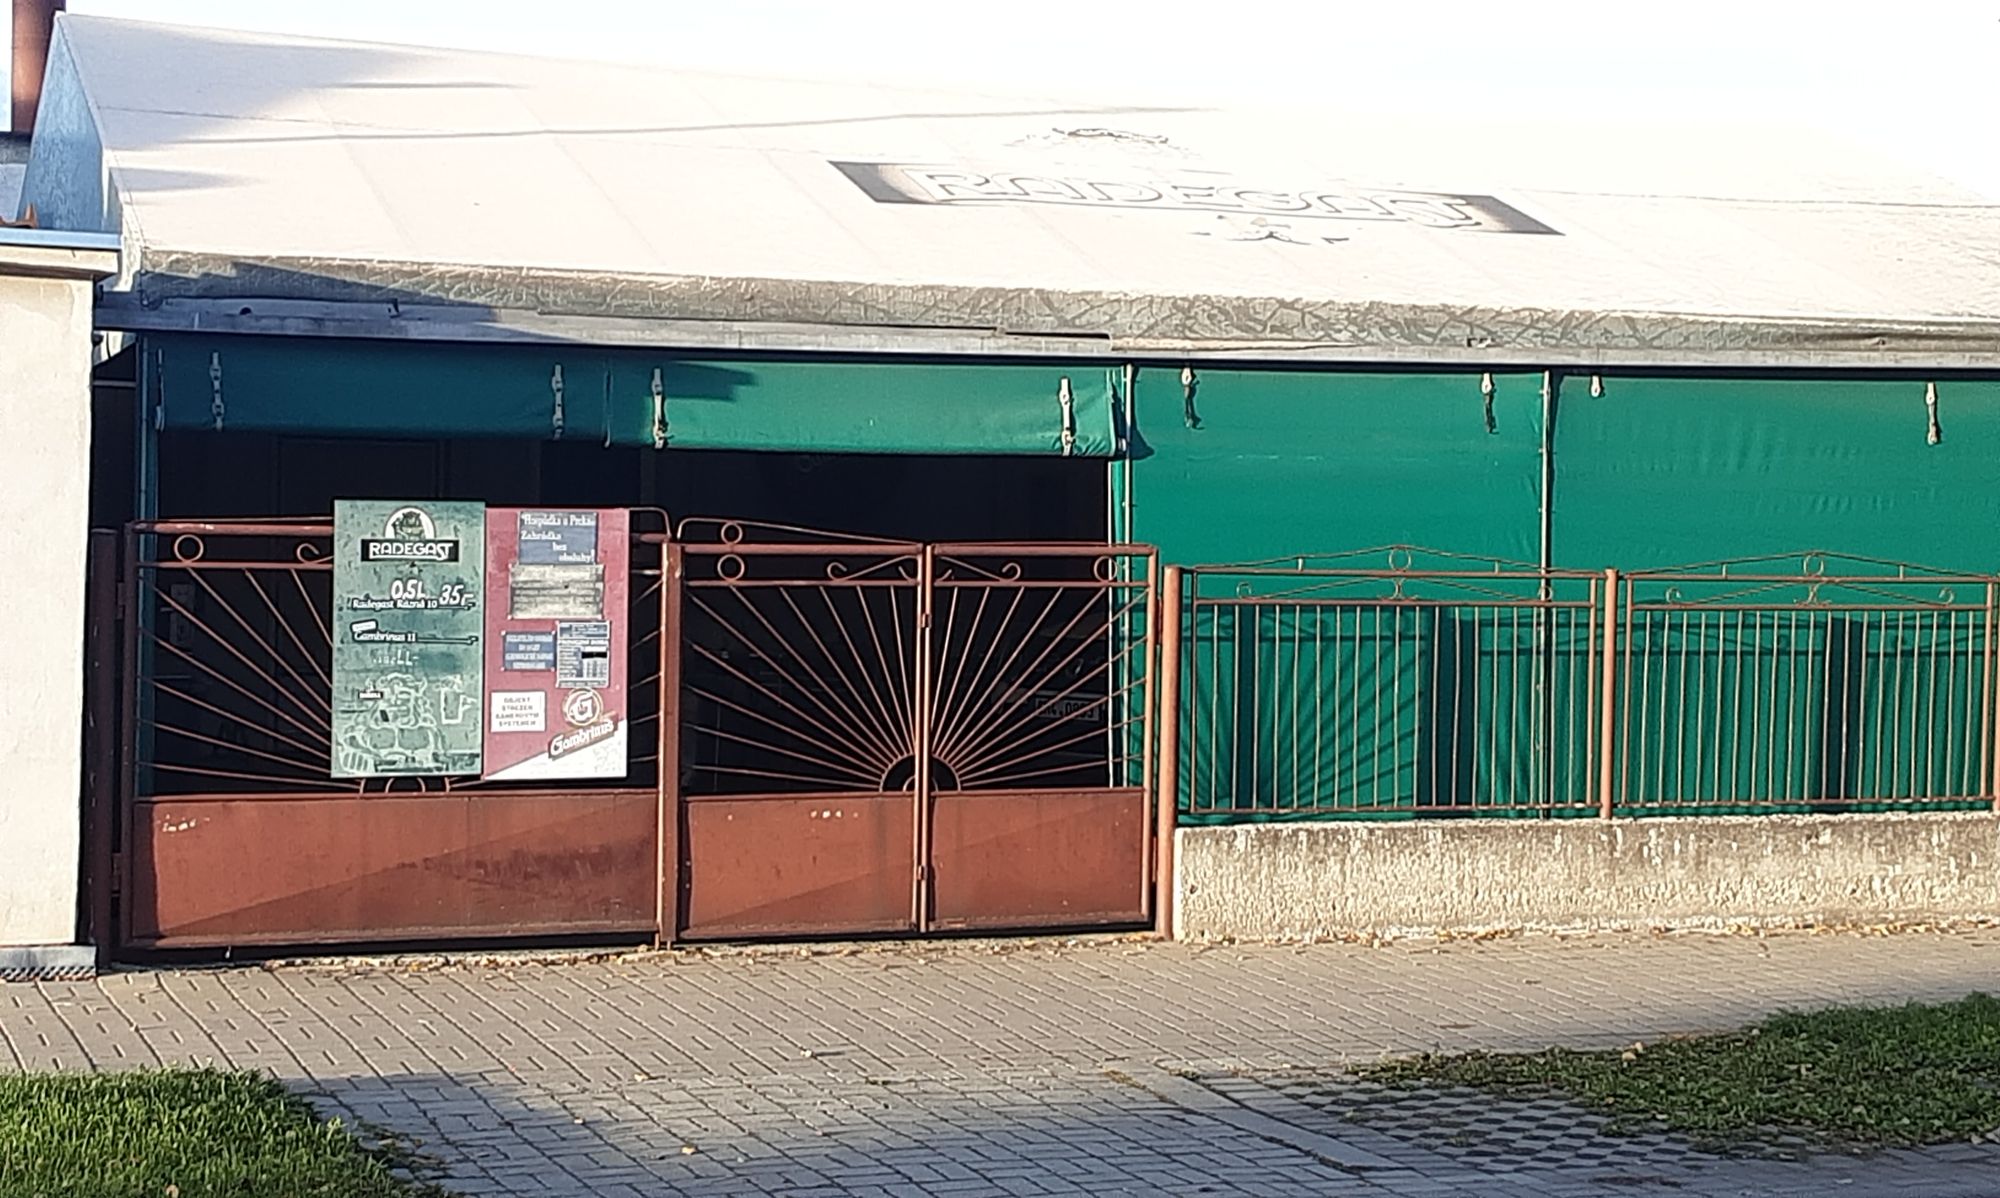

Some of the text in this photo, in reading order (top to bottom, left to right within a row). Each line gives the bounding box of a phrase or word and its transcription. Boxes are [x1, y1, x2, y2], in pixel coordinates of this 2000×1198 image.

[905, 168, 1482, 228] RADEGAST
[368, 542, 454, 561] RADEGAST
[352, 600, 394, 611] Radegast
[427, 600, 438, 608] 10
[550, 718, 615, 756] Gambrinus
